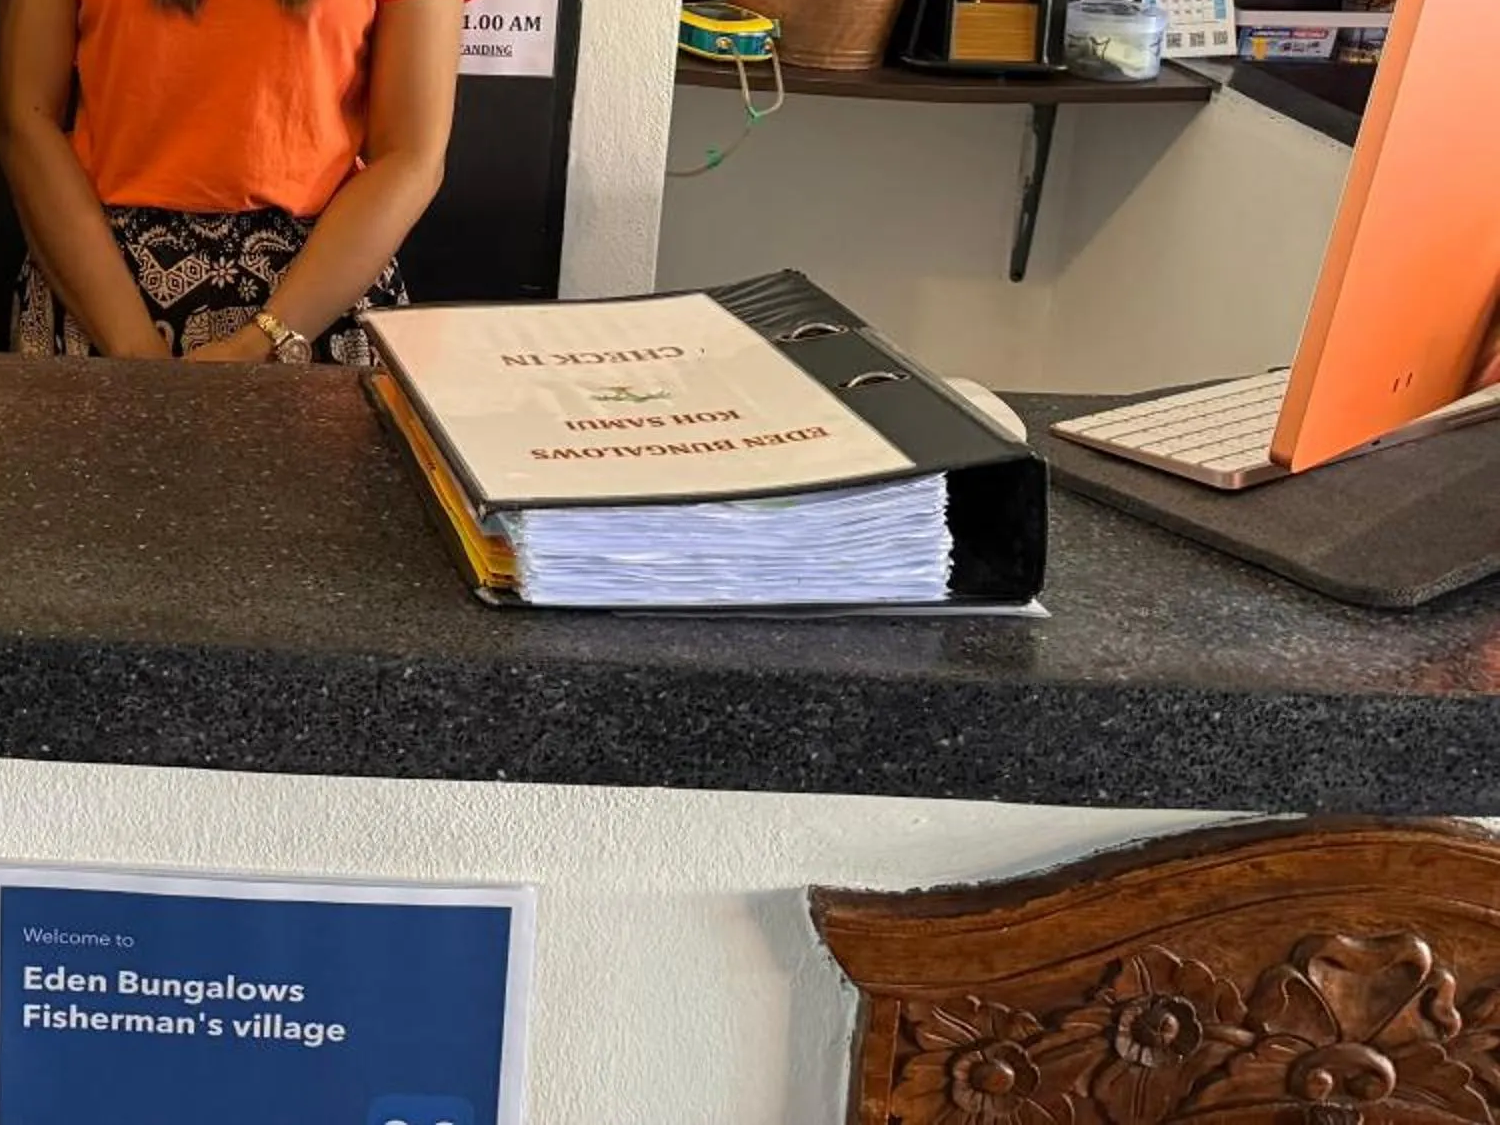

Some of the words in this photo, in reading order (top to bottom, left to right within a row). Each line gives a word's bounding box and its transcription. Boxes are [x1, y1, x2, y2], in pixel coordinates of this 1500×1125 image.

[462, 15, 503, 31] 1.00
[509, 16, 541, 31] AM
[501, 354, 545, 367] IN
[552, 346, 685, 366] CHECK
[566, 416, 665, 431] SAMUI
[673, 409, 741, 426] KOH
[742, 426, 831, 450] EDEN
[531, 439, 738, 460] BUNGALOWS
[23, 926, 110, 947] Welcome
[116, 932, 135, 948] to
[23, 966, 108, 994] Eden
[118, 970, 305, 1004] Bungalows
[23, 1005, 223, 1037] Fisherman's
[233, 1014, 346, 1047] village
